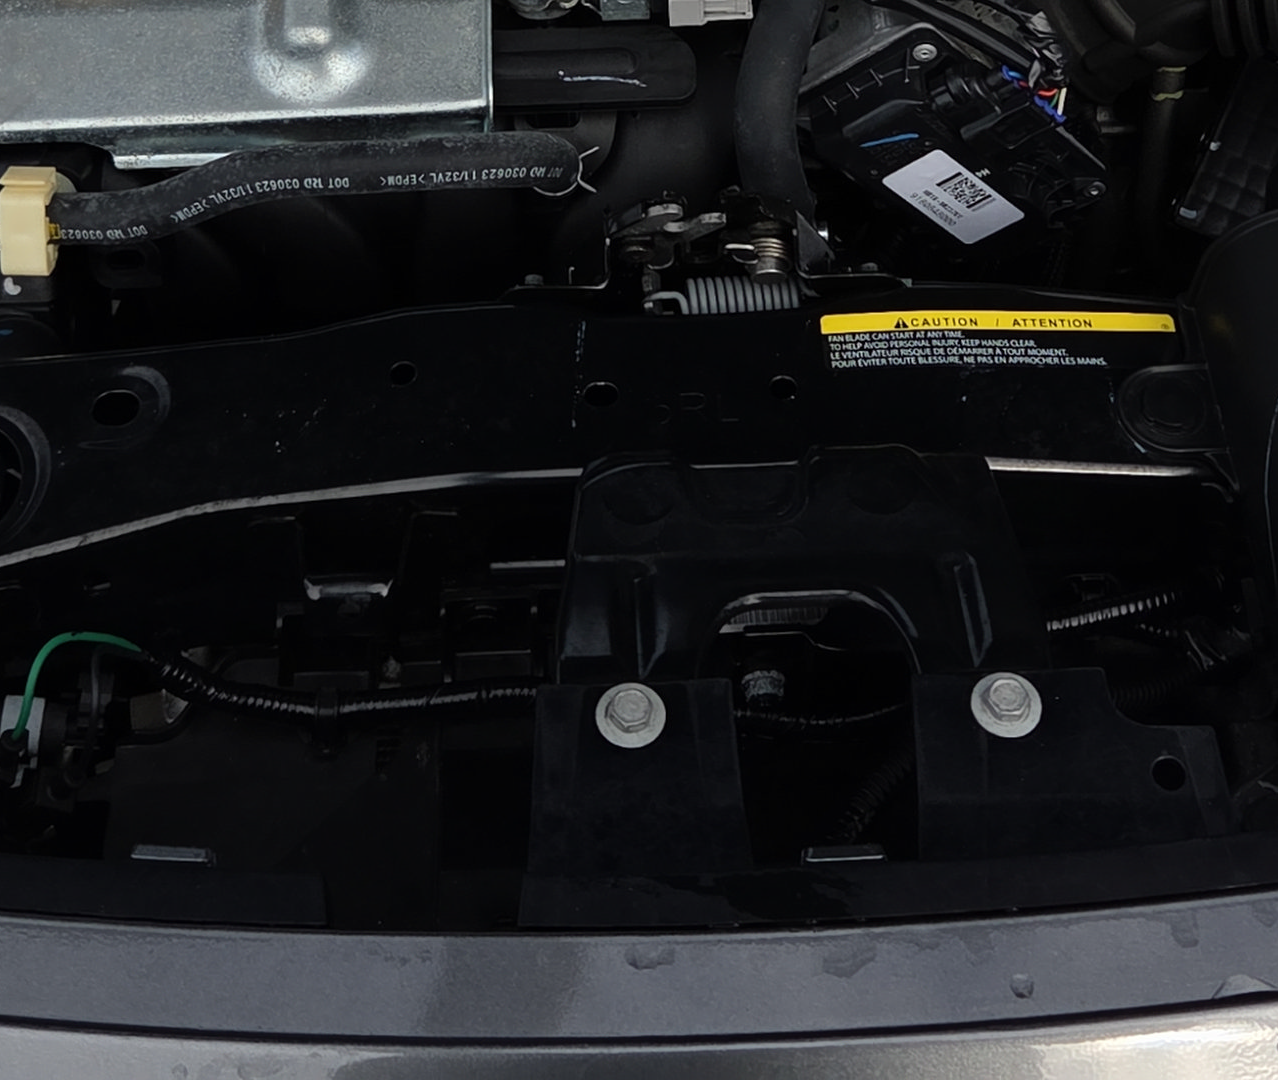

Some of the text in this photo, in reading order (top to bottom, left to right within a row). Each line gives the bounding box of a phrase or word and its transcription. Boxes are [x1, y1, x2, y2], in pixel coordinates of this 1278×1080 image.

[481, 166, 527, 180] 030623
[255, 178, 301, 194] 030623
[328, 177, 350, 188] DOT
[61, 230, 104, 241] 030623
[125, 224, 149, 238] DOT
[910, 316, 979, 328] CAUTION
[1012, 317, 1093, 329] ATTENTION
[828, 334, 844, 343] FAN
[845, 333, 871, 342] BLADE
[872, 332, 890, 341] CAN
[890, 331, 914, 340] START
[915, 331, 925, 339] AT
[927, 331, 942, 339] ANY
[830, 342, 841, 351] TO
[842, 341, 862, 351] HELP
[863, 340, 889, 350] AVOID
[890, 339, 931, 349] PERSONAL
[961, 338, 981, 347] KEEP
[982, 338, 1009, 347] HANDS
[830, 351, 840, 360] LE
[841, 349, 899, 359] VENTILATEUR
[900, 347, 932, 357] RISQUE
[933, 347, 945, 356] DE
[946, 346, 994, 356] DÉMARRER
[1003, 347, 1026, 356] TOUT
[1027, 348, 1070, 357] MOMENT.
[831, 360, 857, 369] POUR
[857, 357, 888, 368] ÉVITER
[889, 356, 916, 366] TOUTE
[963, 355, 975, 365] NE
[977, 355, 994, 365] PAS
[995, 356, 1007, 365] EN
[1008, 356, 1060, 366] APPROCHER
[1061, 357, 1076, 366] LES
